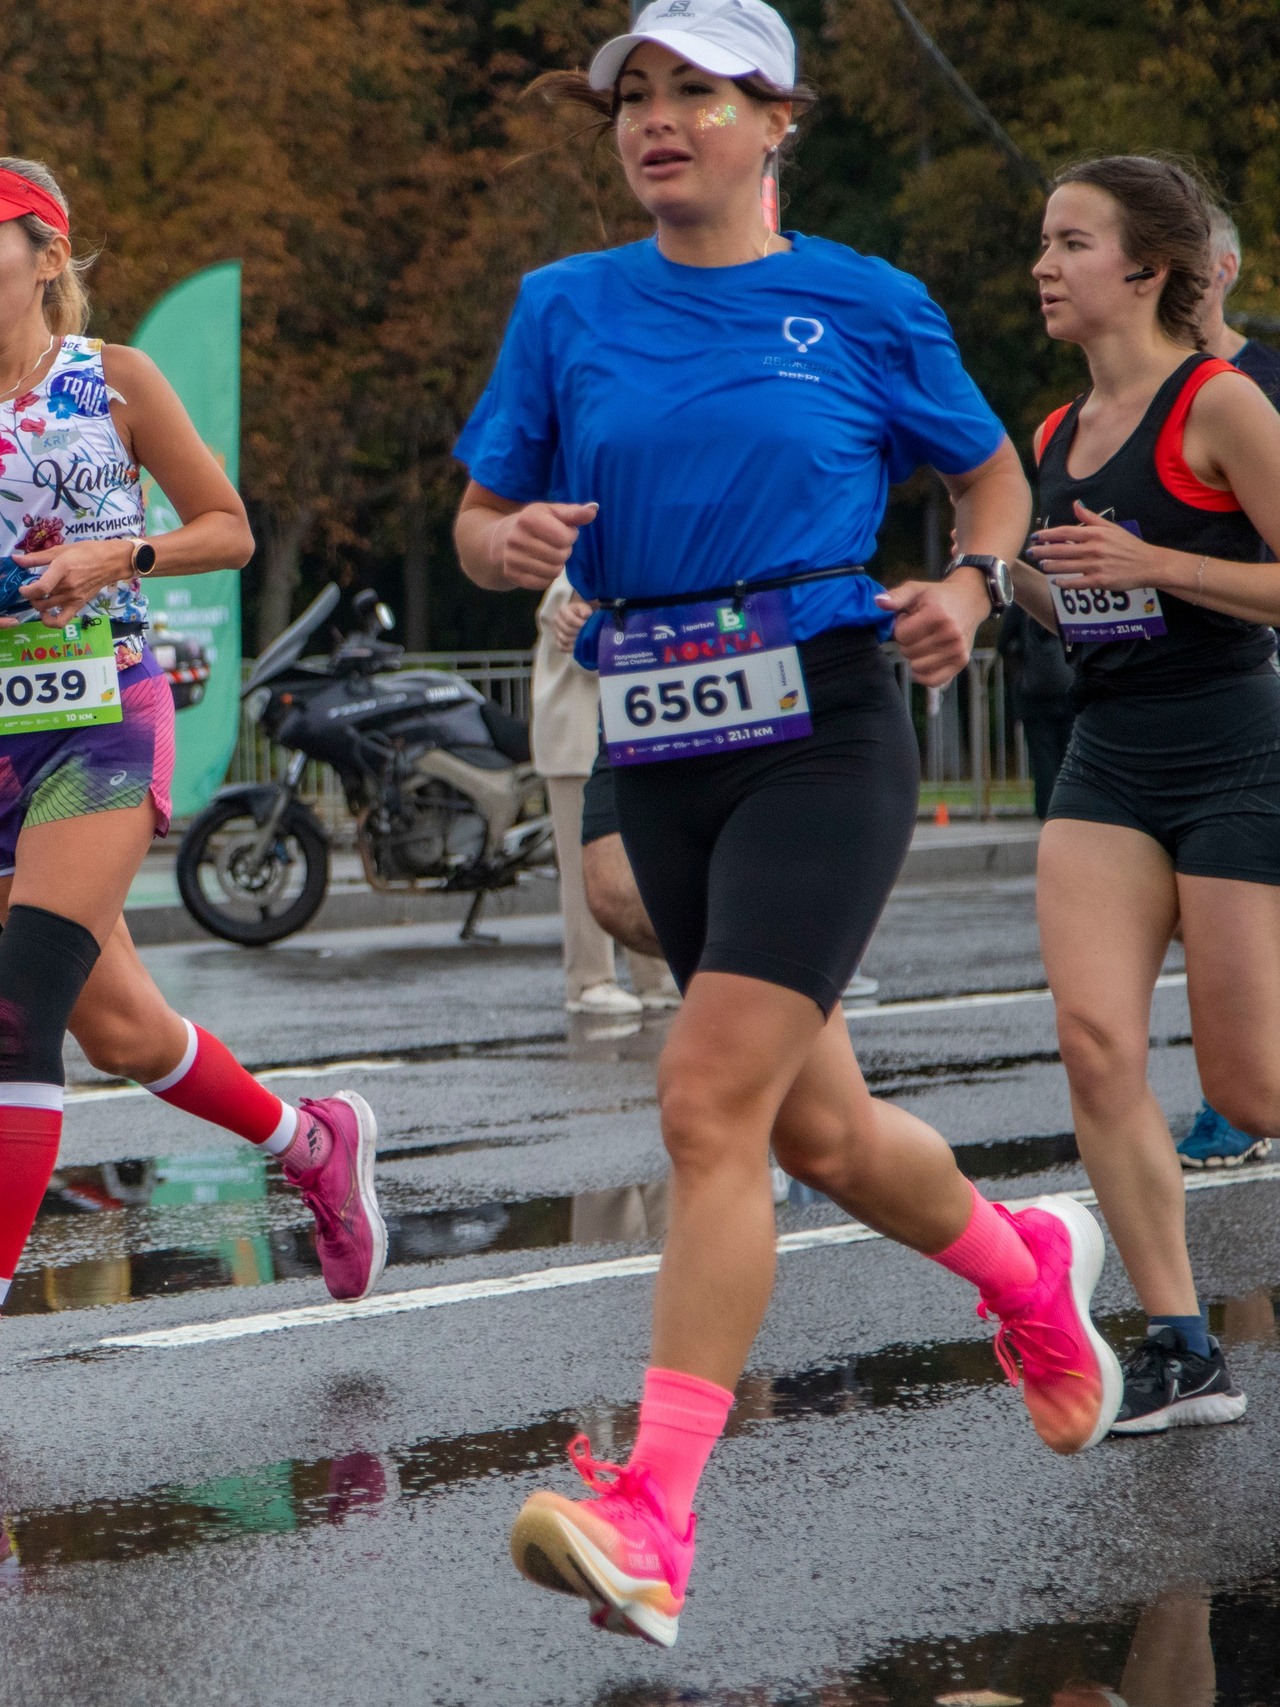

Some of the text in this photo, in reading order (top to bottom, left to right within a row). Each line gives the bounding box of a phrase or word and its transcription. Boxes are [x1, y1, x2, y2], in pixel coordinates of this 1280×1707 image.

[624, 669, 753, 728] 6561
[66, 713, 77, 722] 10
[728, 728, 751, 742] 21.1
